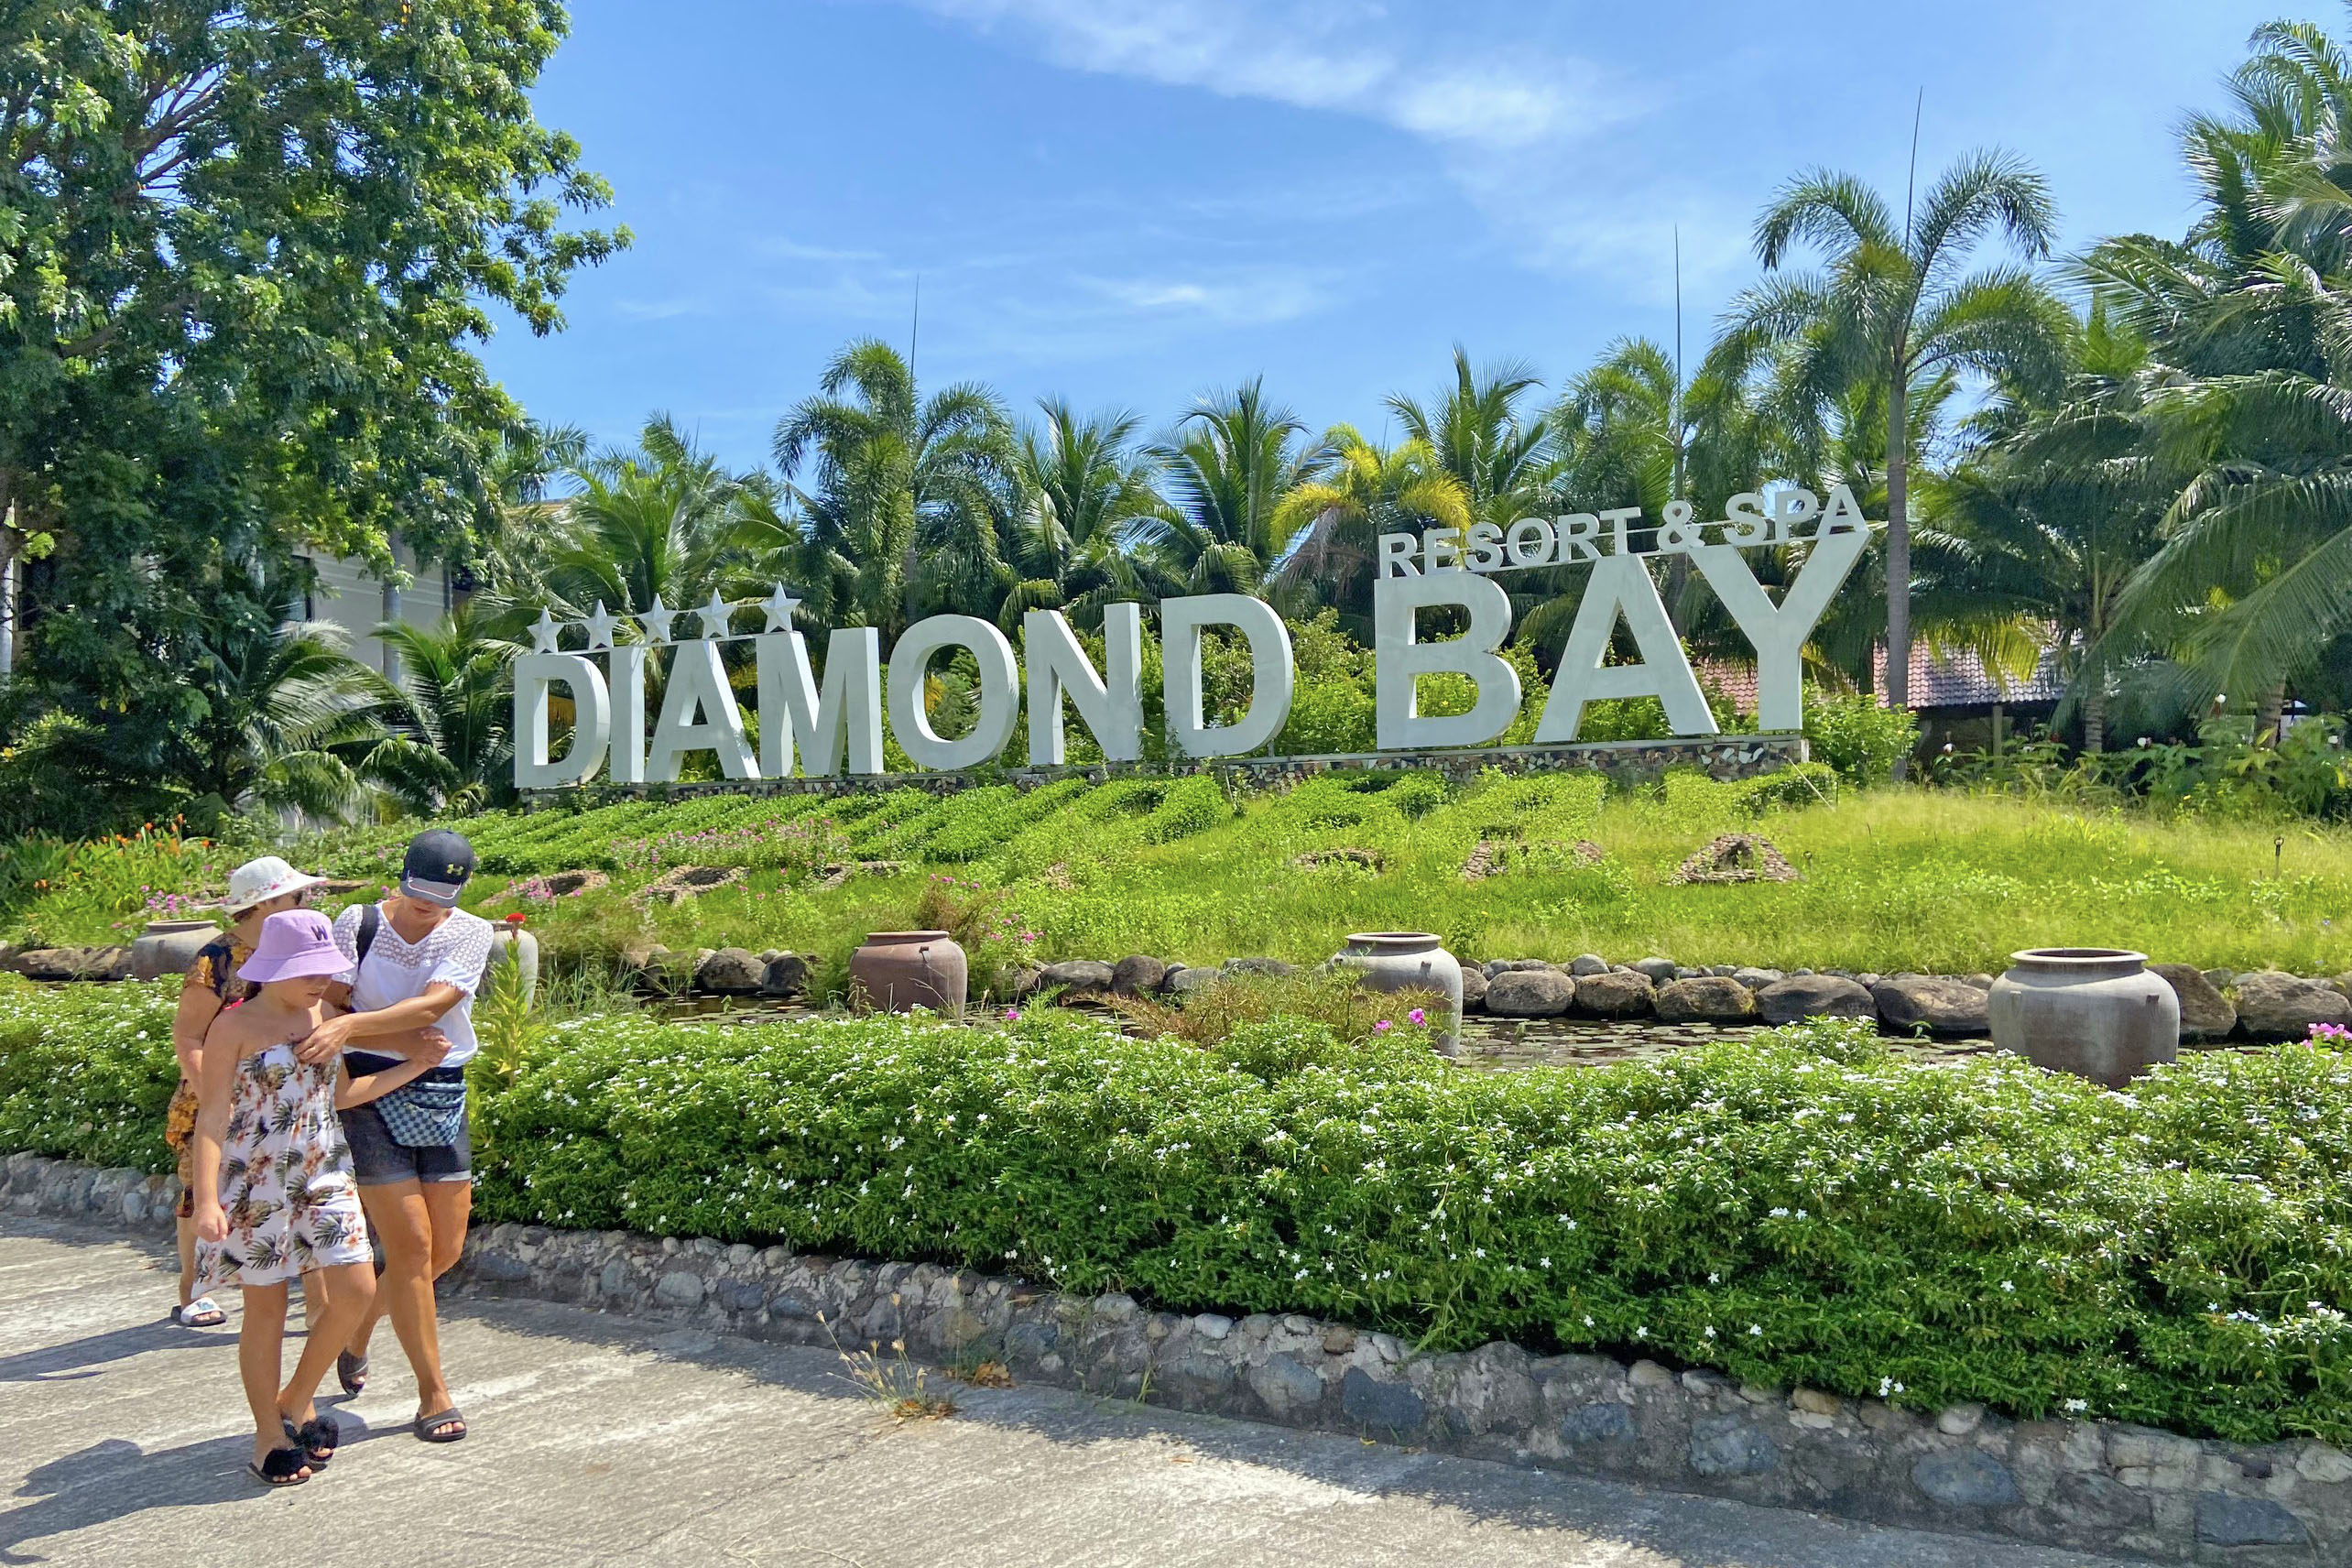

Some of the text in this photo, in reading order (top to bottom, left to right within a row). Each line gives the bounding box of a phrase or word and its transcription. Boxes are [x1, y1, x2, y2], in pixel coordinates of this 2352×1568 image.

[1377, 484, 1869, 579] RESORT & SPA
[514, 529, 1872, 789] DIAMOND BAY
